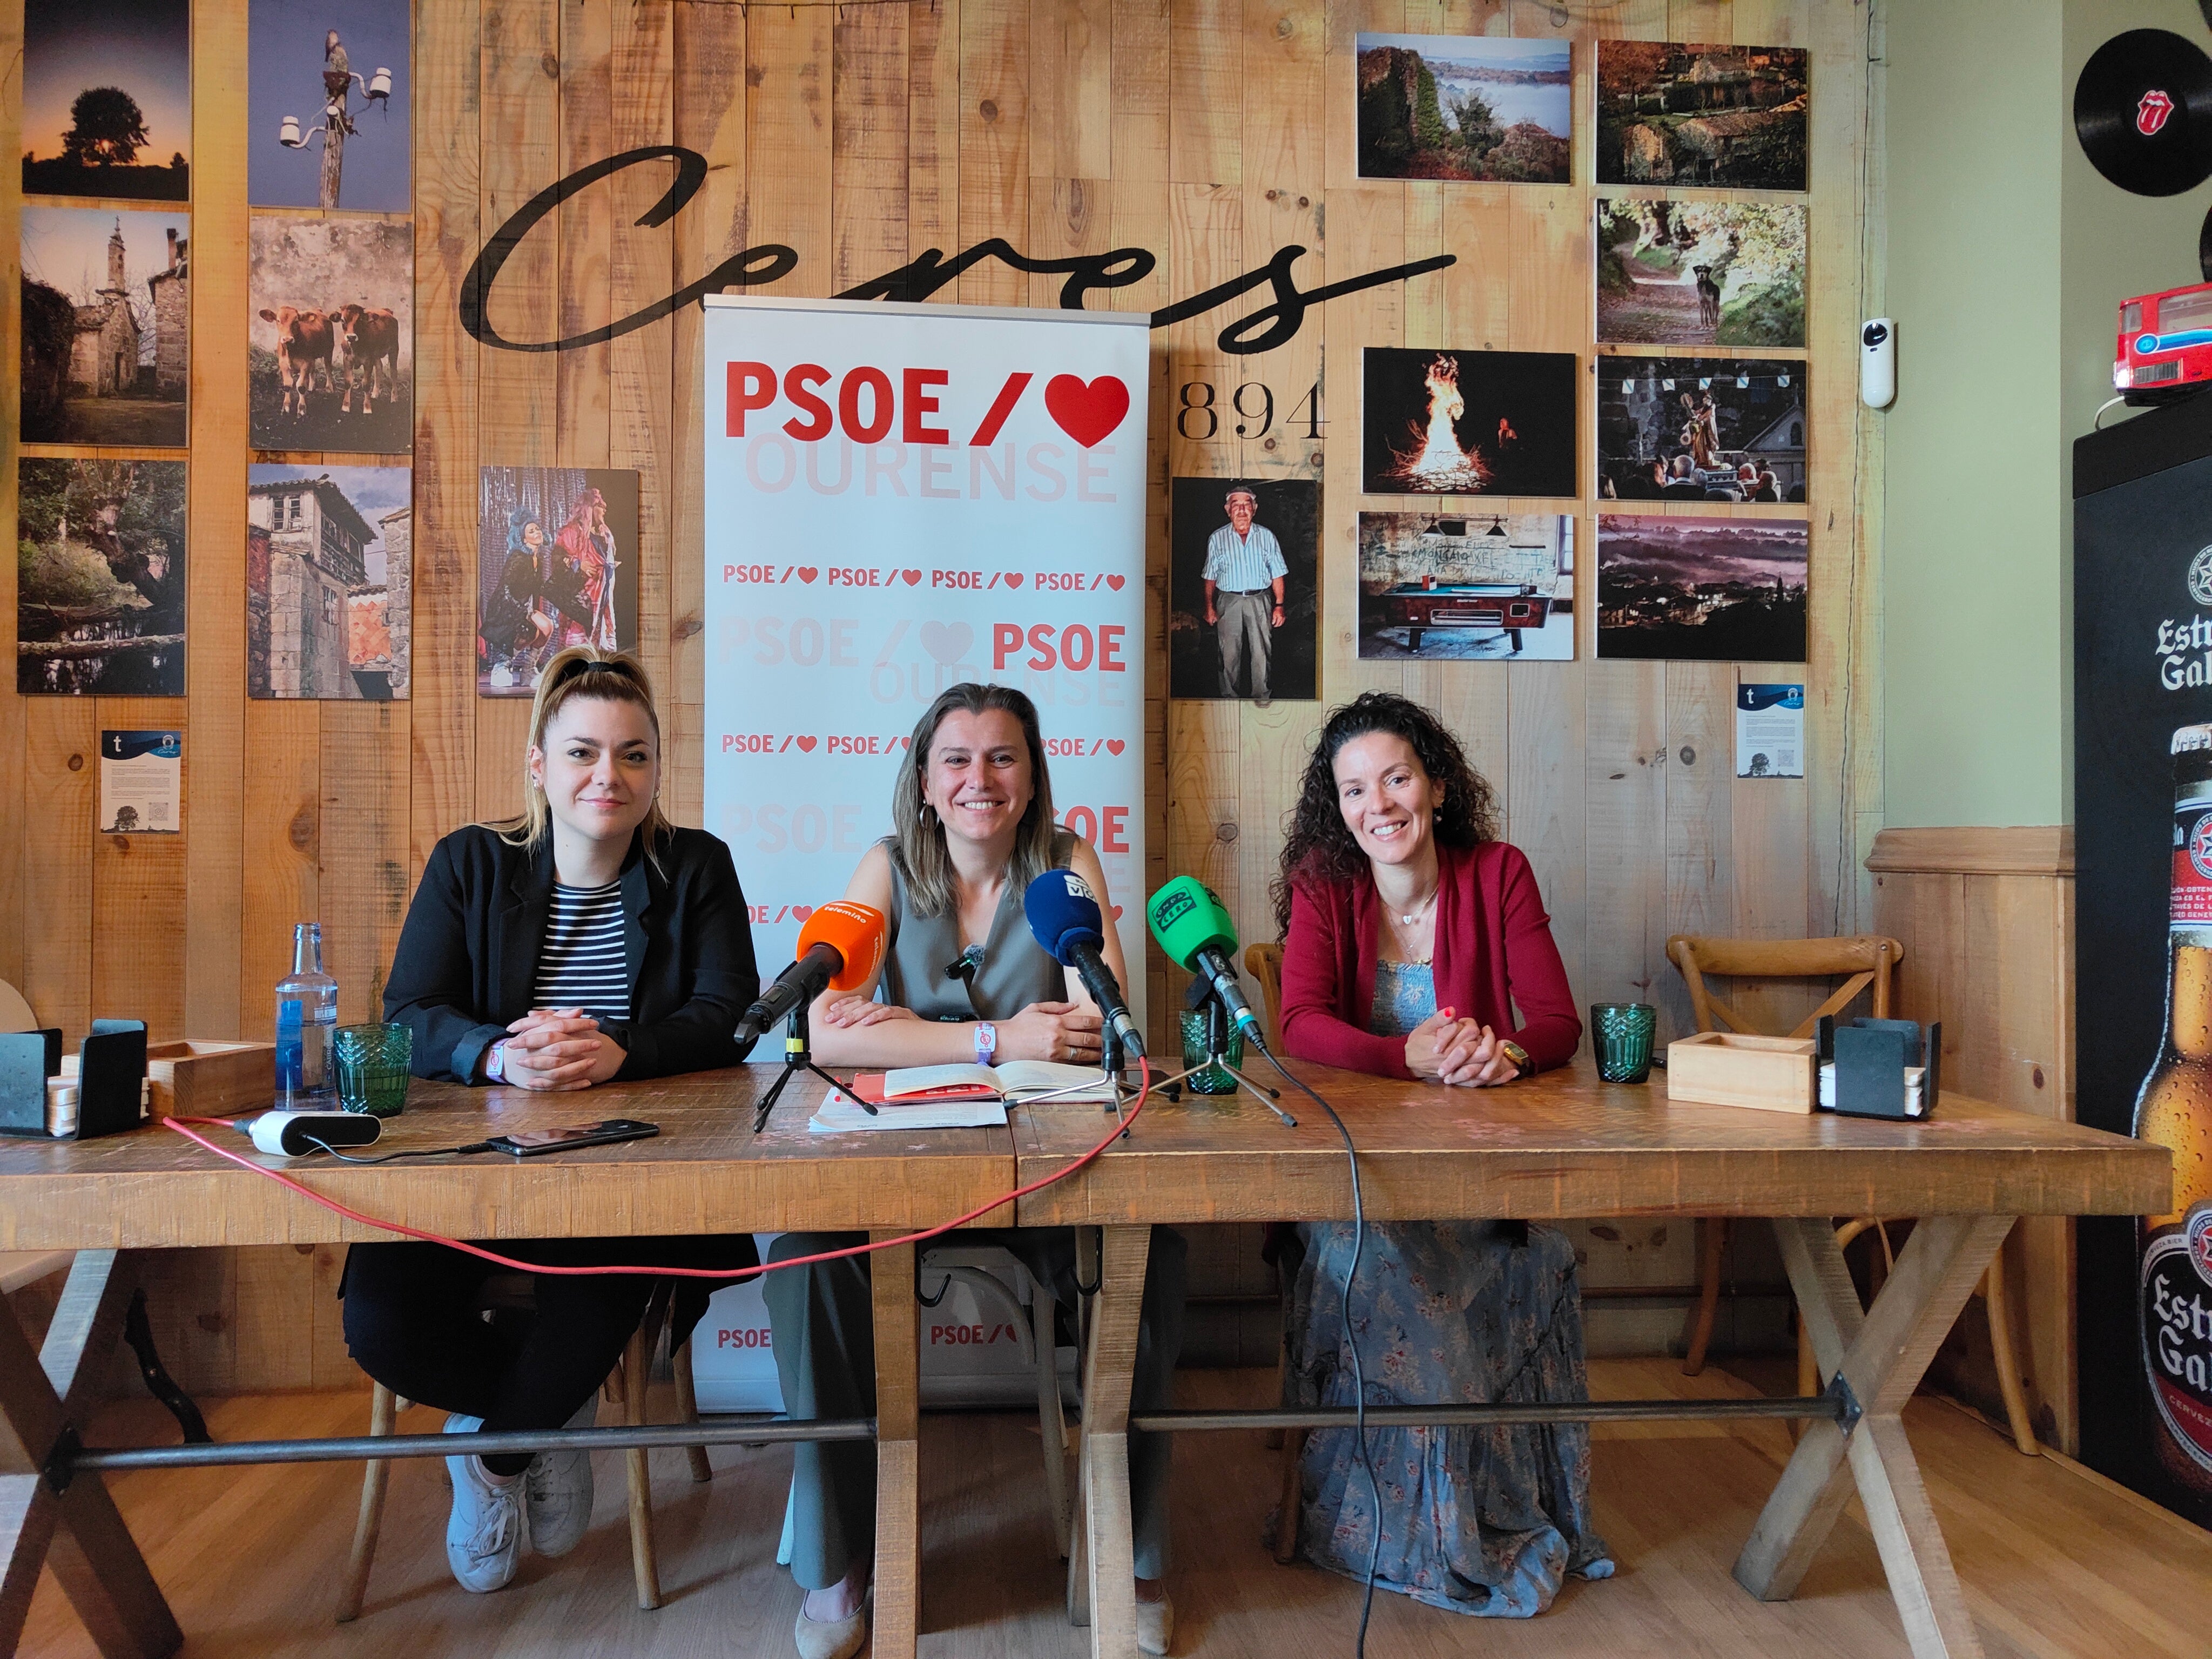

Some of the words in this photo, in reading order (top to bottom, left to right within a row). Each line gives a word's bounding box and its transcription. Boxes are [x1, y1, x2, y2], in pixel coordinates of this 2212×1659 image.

[726, 361, 949, 446] PSOE
[745, 433, 1117, 503] OURENSE
[724, 565, 775, 584] PSOE
[828, 567, 880, 587] PSOE
[932, 570, 983, 589] PSOE
[1035, 572, 1085, 591] PSOE
[718, 616, 858, 667] PSOE
[993, 624, 1126, 672] PSOE
[722, 734, 774, 754] PSOE
[827, 736, 879, 755] PSOE
[721, 804, 862, 854] PSOE
[824, 906, 867, 923] telemiño
[1157, 894, 1183, 915] ONDA
[1164, 901, 1188, 922] CERO
[718, 1329, 771, 1348] PSOE
[930, 1325, 983, 1344] PSOE
